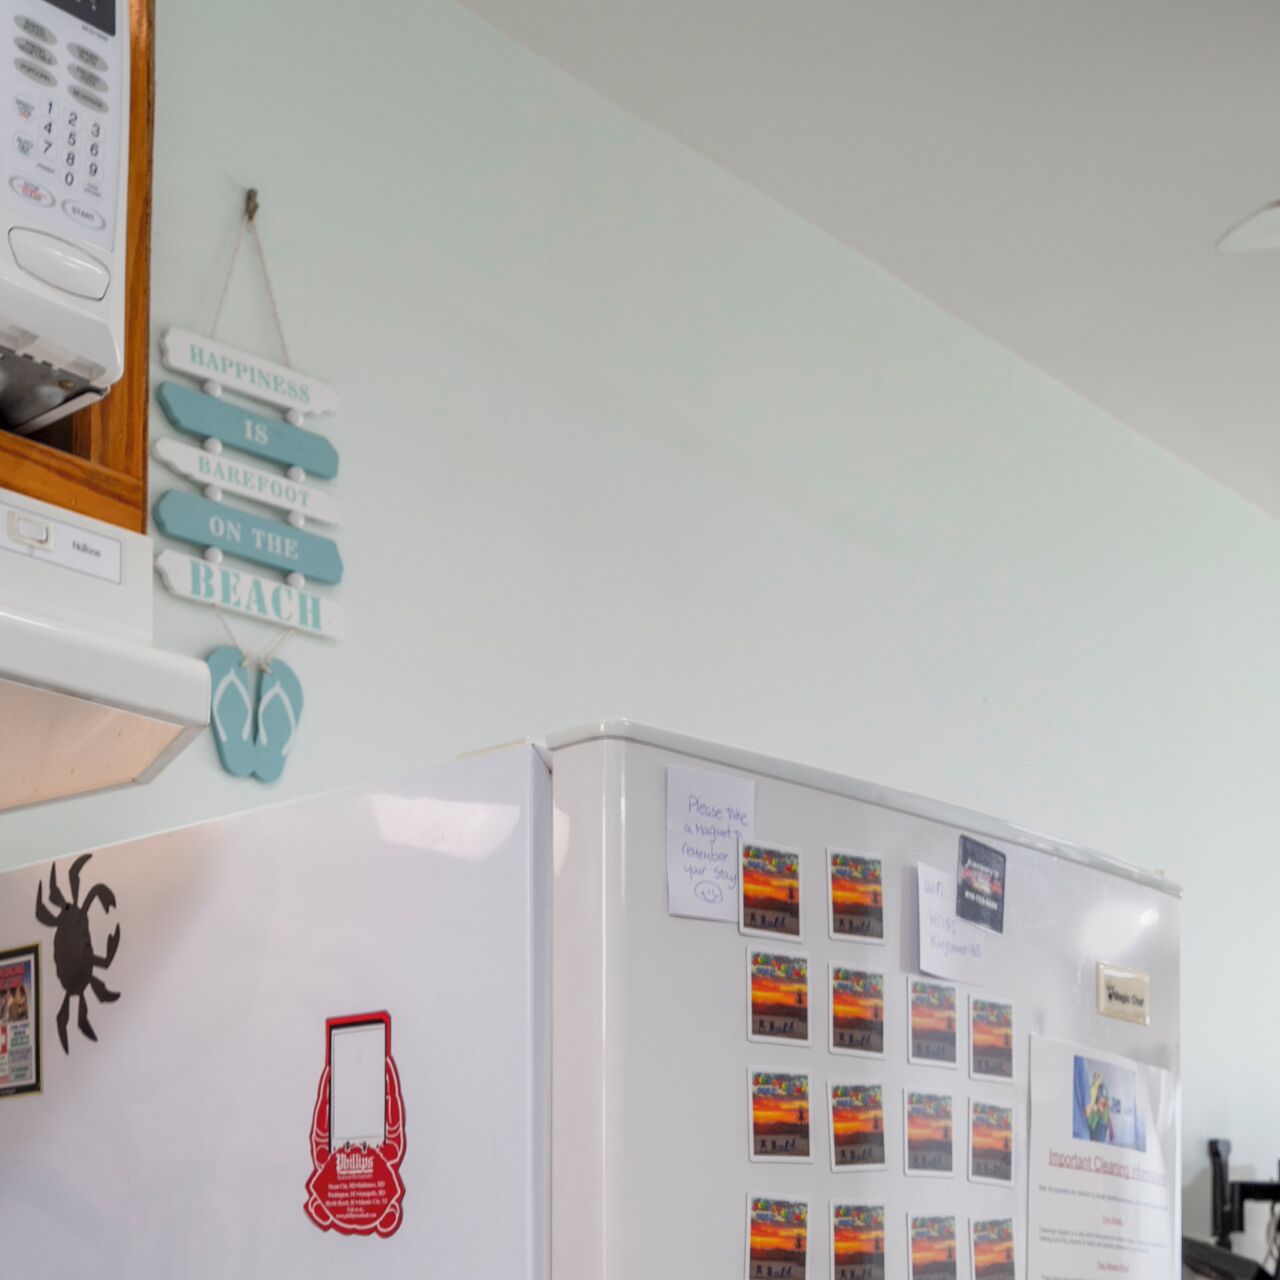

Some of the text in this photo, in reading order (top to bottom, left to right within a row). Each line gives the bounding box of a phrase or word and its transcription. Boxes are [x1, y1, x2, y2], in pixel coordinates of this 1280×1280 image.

[47, 100, 101, 138] 1 2 3
[43, 121, 99, 158] 4 5 6
[43, 140, 99, 178] 7 8 9
[64, 171, 75, 187] 0
[71, 204, 95, 222] START
[189, 344, 311, 404] HAPPINESS
[243, 419, 269, 445] IS
[198, 454, 311, 508] BAREFOOT
[208, 514, 299, 560] ON THE
[190, 559, 322, 631] BEACH
[688, 794, 723, 820] Please
[335, 1152, 375, 1171] Phillips
[1049, 1148, 1092, 1172] Important
[1093, 1156, 1130, 1180] Cleaning
